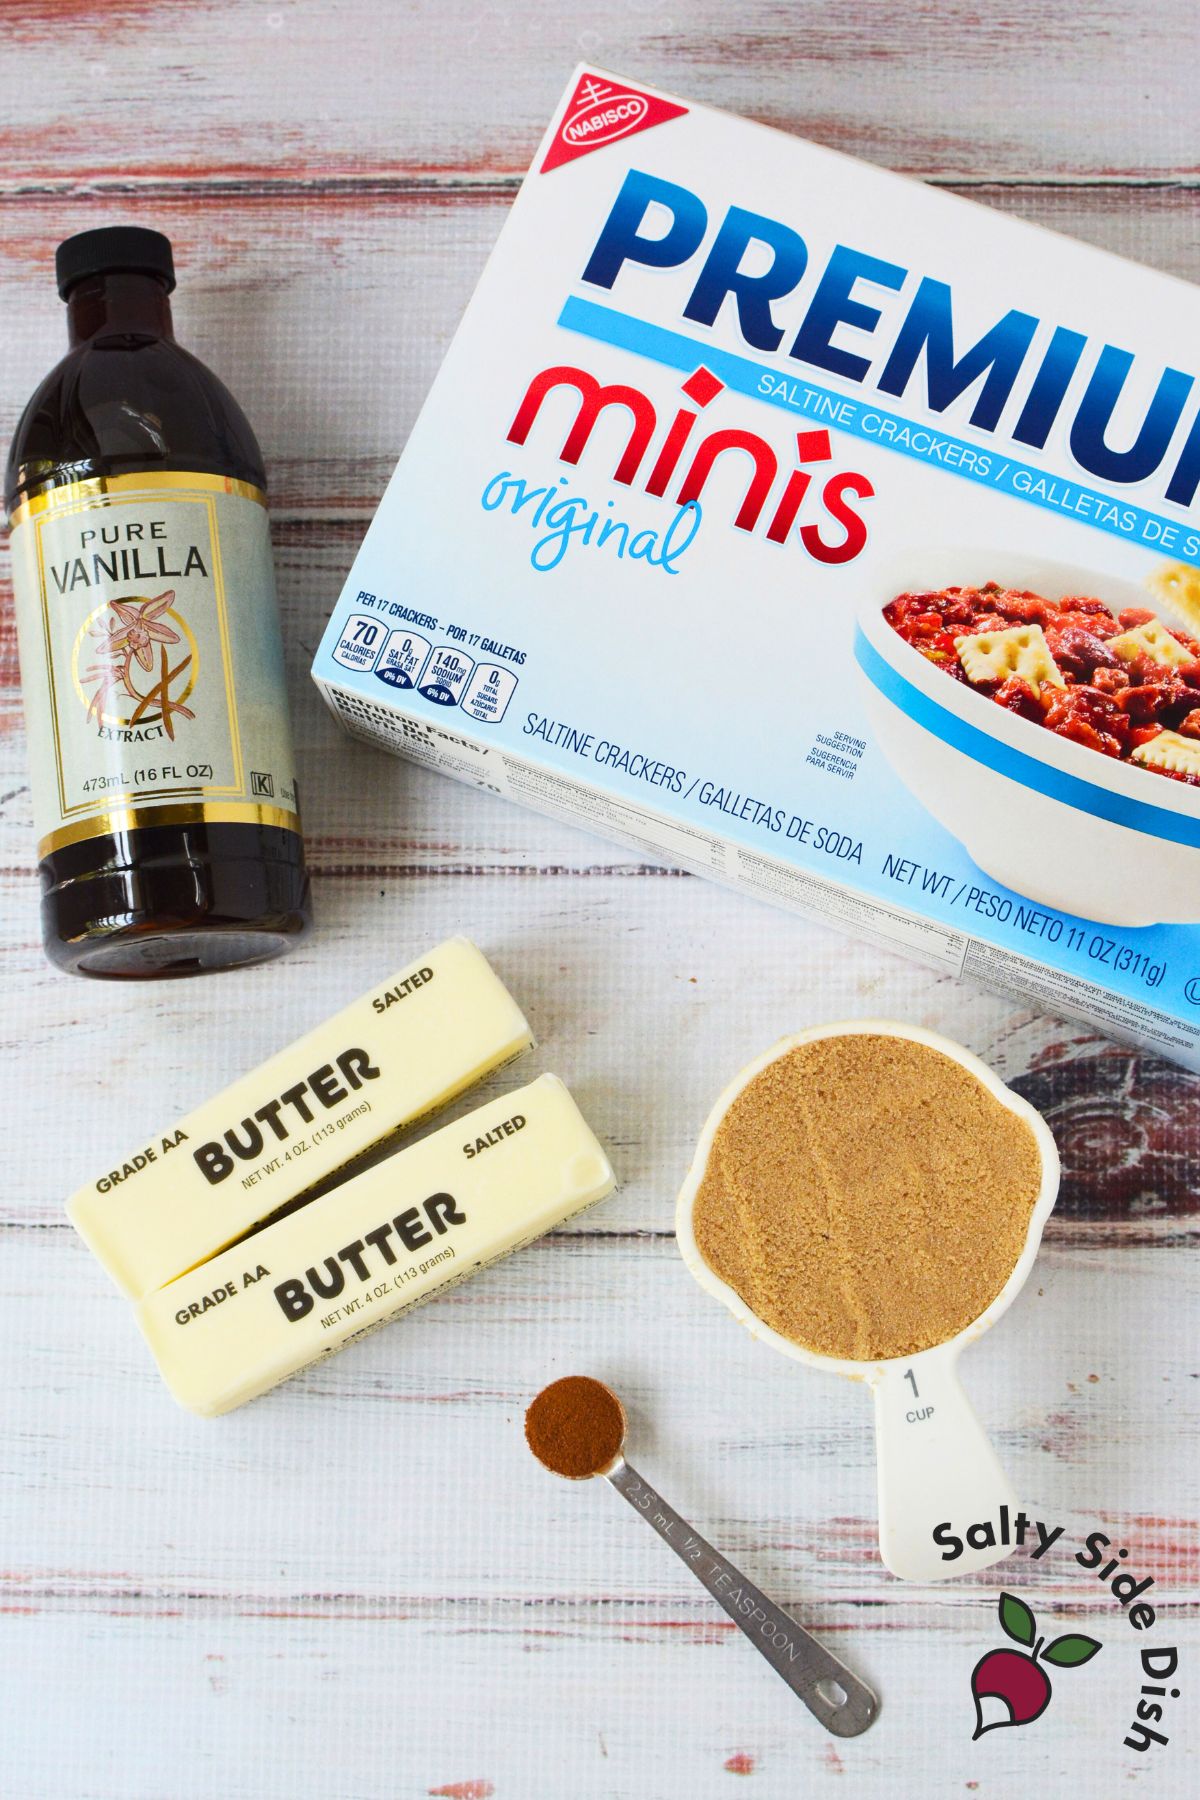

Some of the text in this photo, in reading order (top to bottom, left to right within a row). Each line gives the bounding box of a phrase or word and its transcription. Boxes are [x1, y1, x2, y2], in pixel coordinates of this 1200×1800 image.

[569, 101, 641, 140] NABISCO
[506, 365, 876, 565] minis
[757, 375, 857, 425] SALTINE
[862, 413, 993, 477] CRACKERS
[1012, 471, 1137, 531] GALLETAS
[1142, 520, 1179, 548] DE
[81, 521, 167, 549] PURE
[481, 471, 703, 575] original
[51, 545, 209, 594] VANILLA
[352, 621, 378, 646] 70
[356, 591, 376, 607] PER
[377, 597, 389, 612] 17
[388, 603, 438, 631] CRACKERS
[446, 625, 467, 642] POR
[469, 634, 481, 646] 17
[480, 638, 527, 665] GALLETAS
[340, 639, 376, 660] CALORIES
[388, 649, 420, 667] SAT FAT
[402, 639, 414, 656] 0g
[384, 670, 408, 686] 0% DV
[431, 665, 463, 685] SODIUM
[436, 652, 467, 676] 140mg
[482, 684, 498, 696] TOTAL
[489, 671, 501, 687] 0g
[331, 688, 419, 729] Nutrition
[426, 687, 450, 702] 6% DV
[476, 691, 499, 705] SUGARS
[472, 708, 489, 720] TOTAL
[97, 724, 165, 743] EXTRACT
[816, 734, 864, 759] SUGGESTION
[833, 731, 867, 750] SERVING
[805, 755, 855, 780] PARA SERVIR
[811, 747, 857, 771] SUGERENCIA
[82, 765, 213, 792] 473mL (16 FL OZ)
[522, 712, 595, 757] SALTINE
[594, 741, 687, 793] CRACKERS
[683, 778, 700, 799] /
[699, 782, 786, 832] GALLETAS
[786, 816, 814, 844] DE
[813, 827, 864, 865] SODA
[882, 853, 922, 885] NET
[922, 868, 955, 898] WT
[950, 884, 967, 905] /
[965, 886, 1013, 922] PESO
[1013, 906, 1064, 942] NETO
[1067, 927, 1085, 953] 11
[371, 966, 435, 1014] SALTED
[193, 1048, 381, 1186] BUTTER
[241, 1100, 372, 1190] NET WT. 4 OZ. (113 grams)
[462, 1114, 527, 1159] SALTED
[96, 1129, 190, 1194] GRADE AA
[273, 1192, 467, 1323] BUTTER
[174, 1264, 271, 1326] GRADE AA
[320, 1245, 456, 1330] NET WT. 4 OZ. (113 grams)
[903, 1368, 920, 1399] 1
[905, 1406, 935, 1425] CUP
[625, 1481, 801, 1663] 2.5 mL 1/2 TEASPOON
